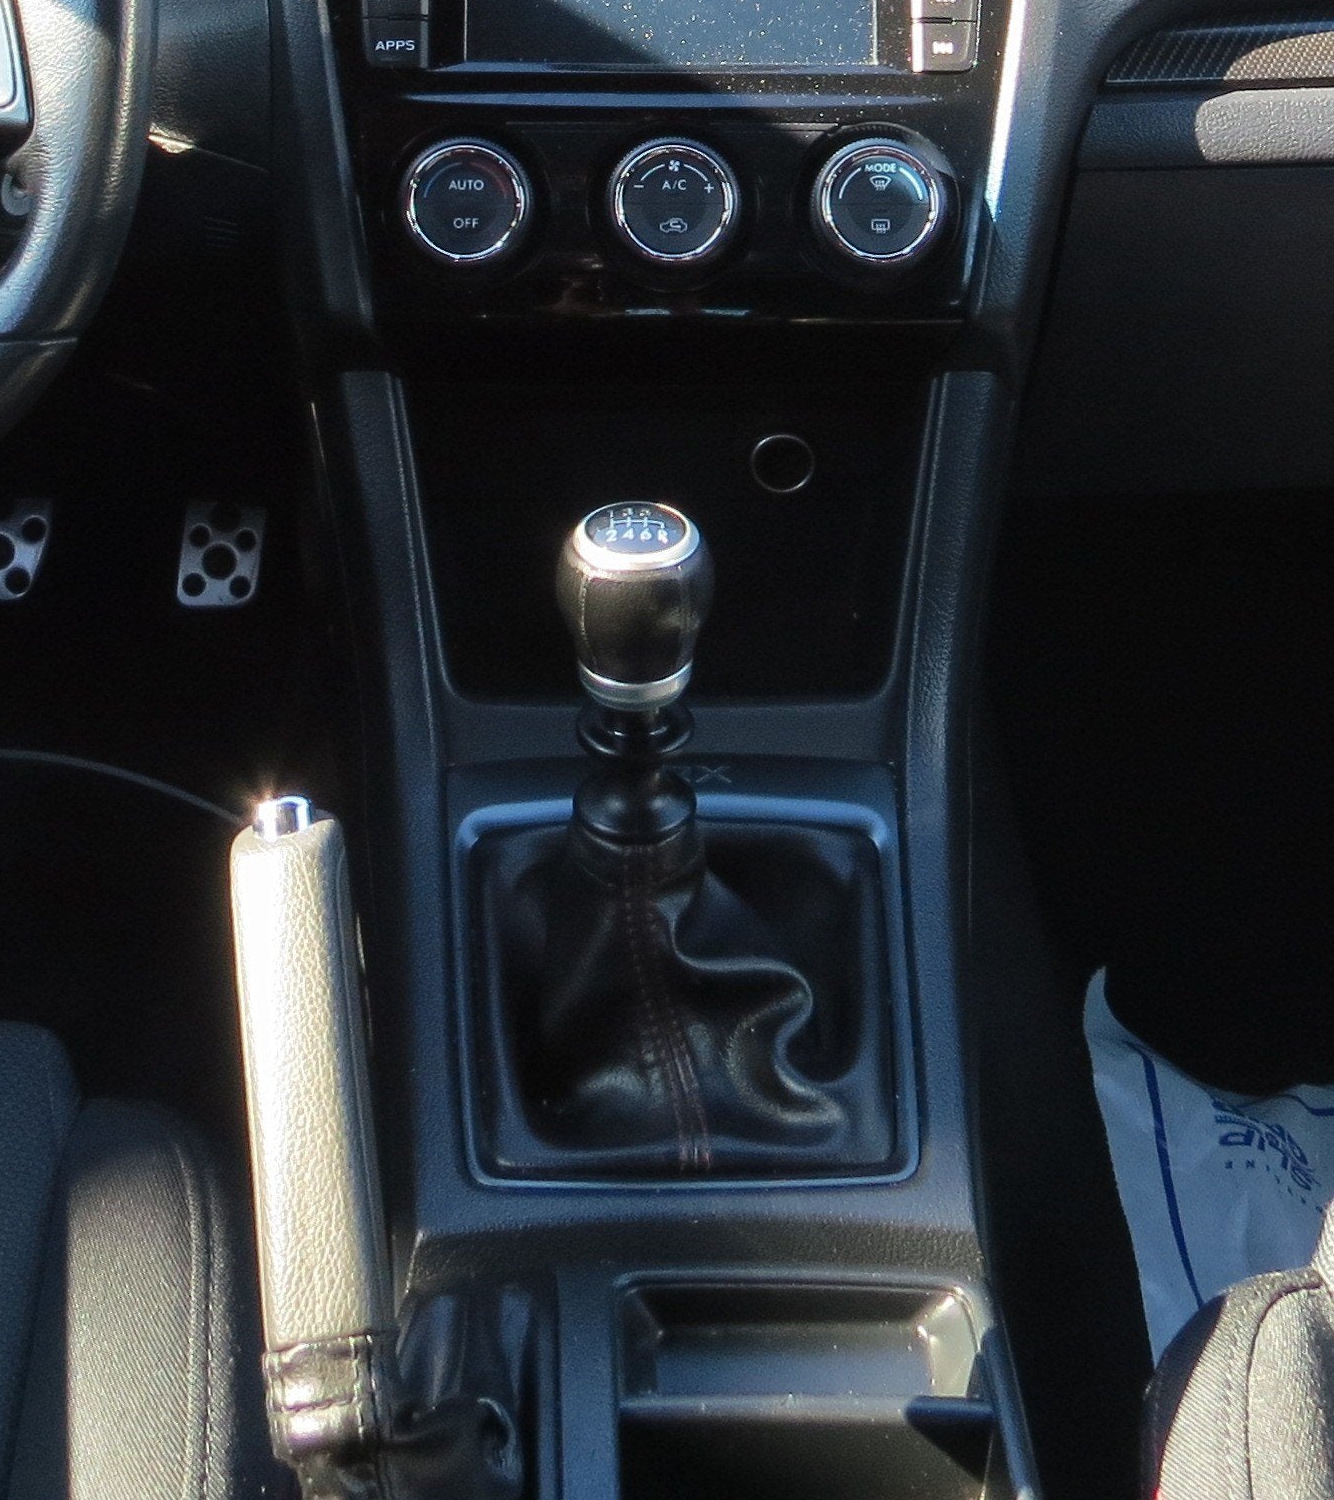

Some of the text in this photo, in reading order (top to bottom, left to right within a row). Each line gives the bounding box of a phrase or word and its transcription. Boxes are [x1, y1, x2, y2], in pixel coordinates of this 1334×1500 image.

[374, 40, 416, 51] APPS
[865, 162, 897, 174] MODE
[448, 179, 485, 191] AUTO
[661, 179, 687, 192] A/C
[452, 217, 480, 229] OFF
[605, 527, 669, 544] 2 4 6 R
